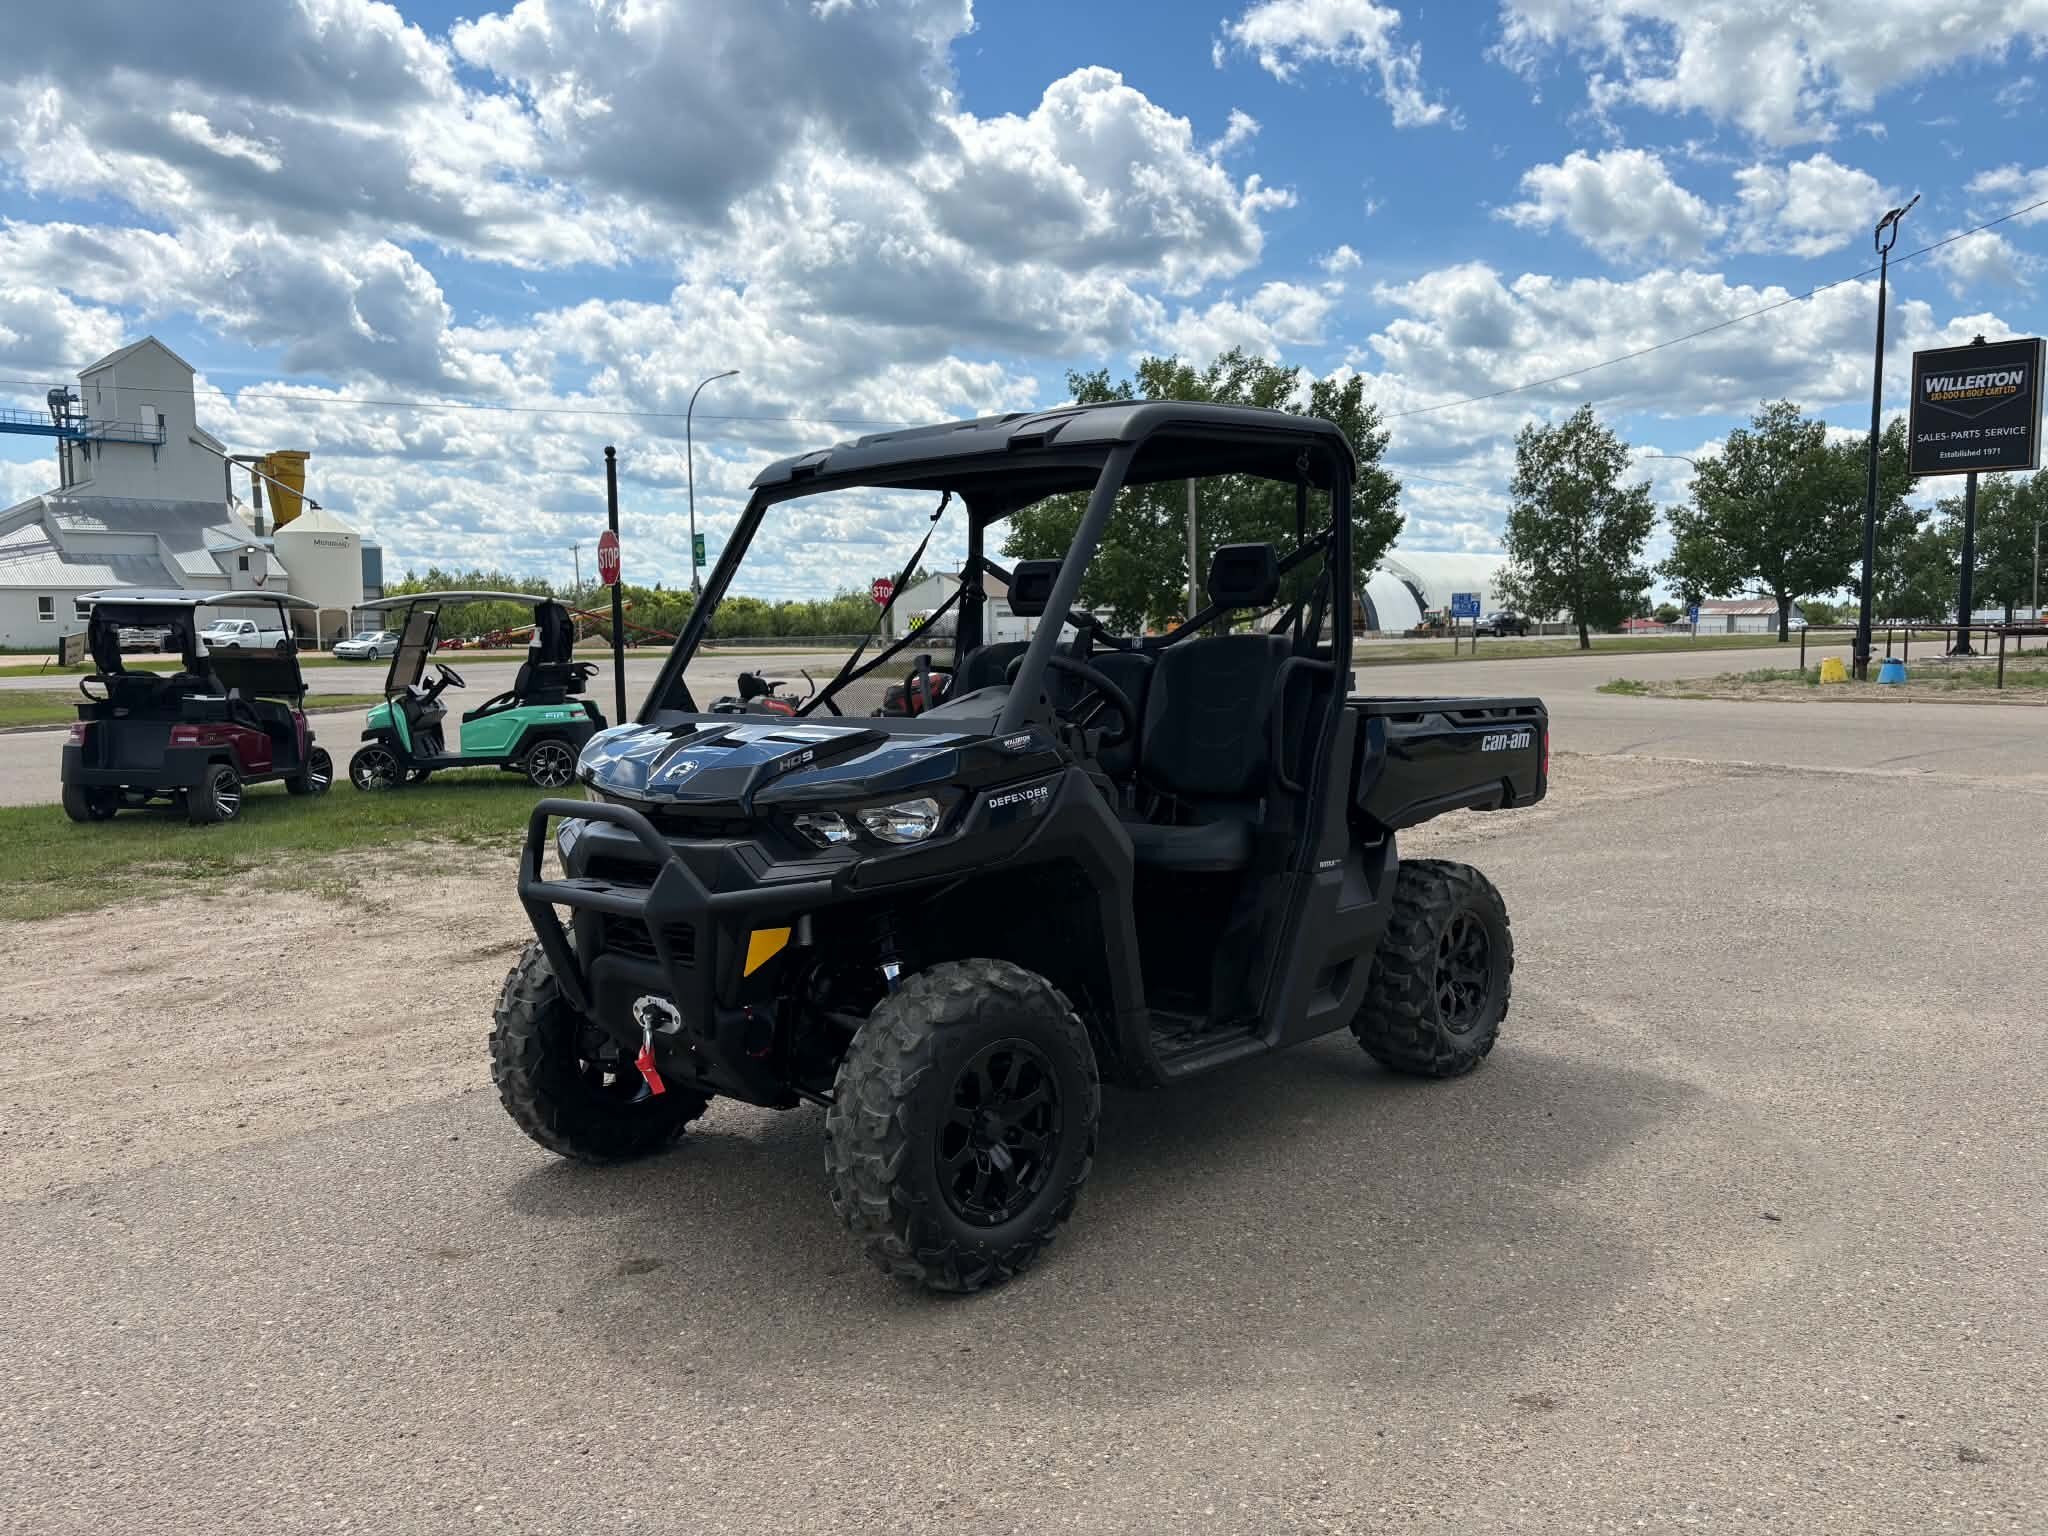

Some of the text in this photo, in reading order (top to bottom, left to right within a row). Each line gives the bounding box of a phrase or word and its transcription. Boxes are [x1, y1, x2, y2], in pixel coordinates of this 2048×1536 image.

[1925, 370, 2023, 392] WILLERTON
[1985, 426, 2027, 437] SERVICE
[1939, 447, 2000, 458] Established 1971
[599, 547, 619, 568] STOP
[1481, 733, 1530, 751] can-am
[989, 786, 1048, 808] DEFENDER
